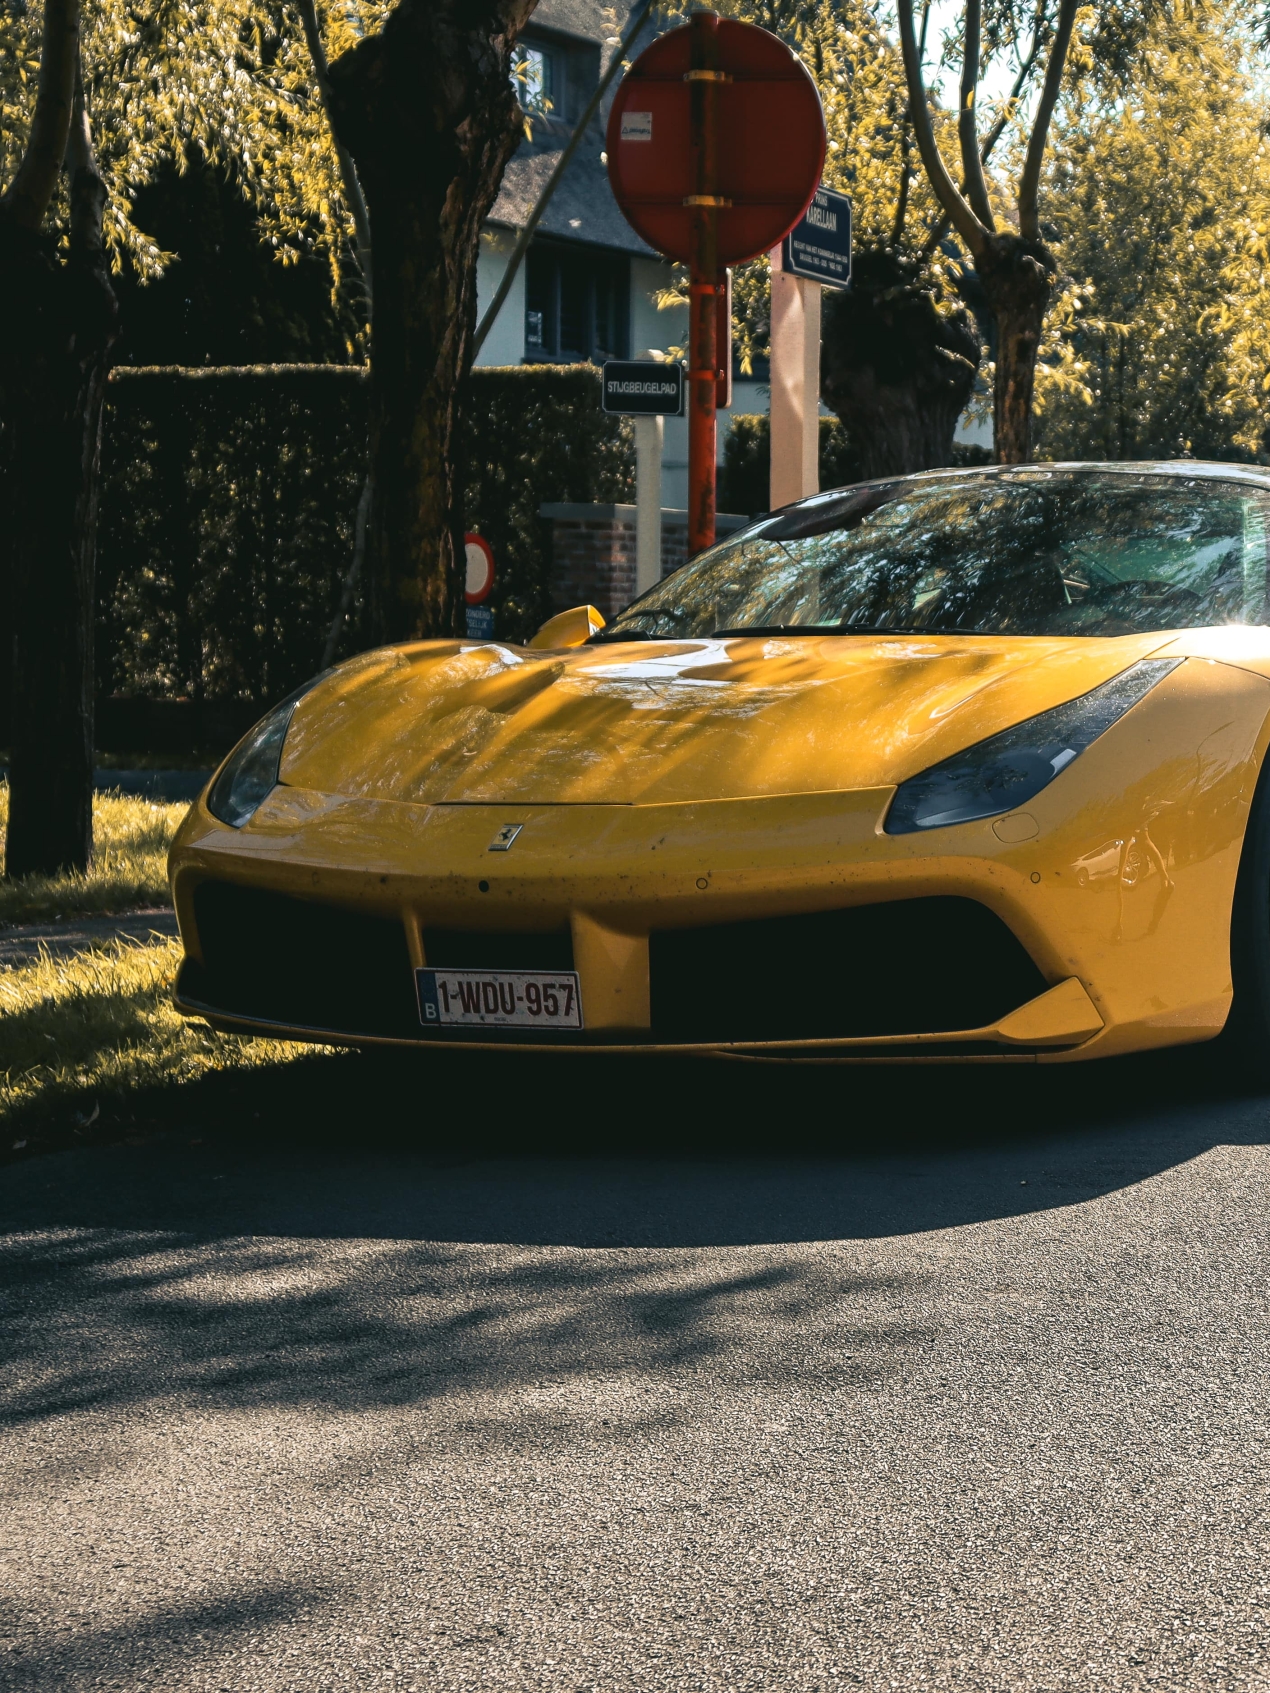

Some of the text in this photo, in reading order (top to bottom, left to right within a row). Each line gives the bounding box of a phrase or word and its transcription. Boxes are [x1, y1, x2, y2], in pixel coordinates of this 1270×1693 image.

[607, 381, 677, 394] STIJGBEUGELPAD
[438, 980, 574, 1017] 1-WDU-957
[425, 1002, 437, 1019] B
